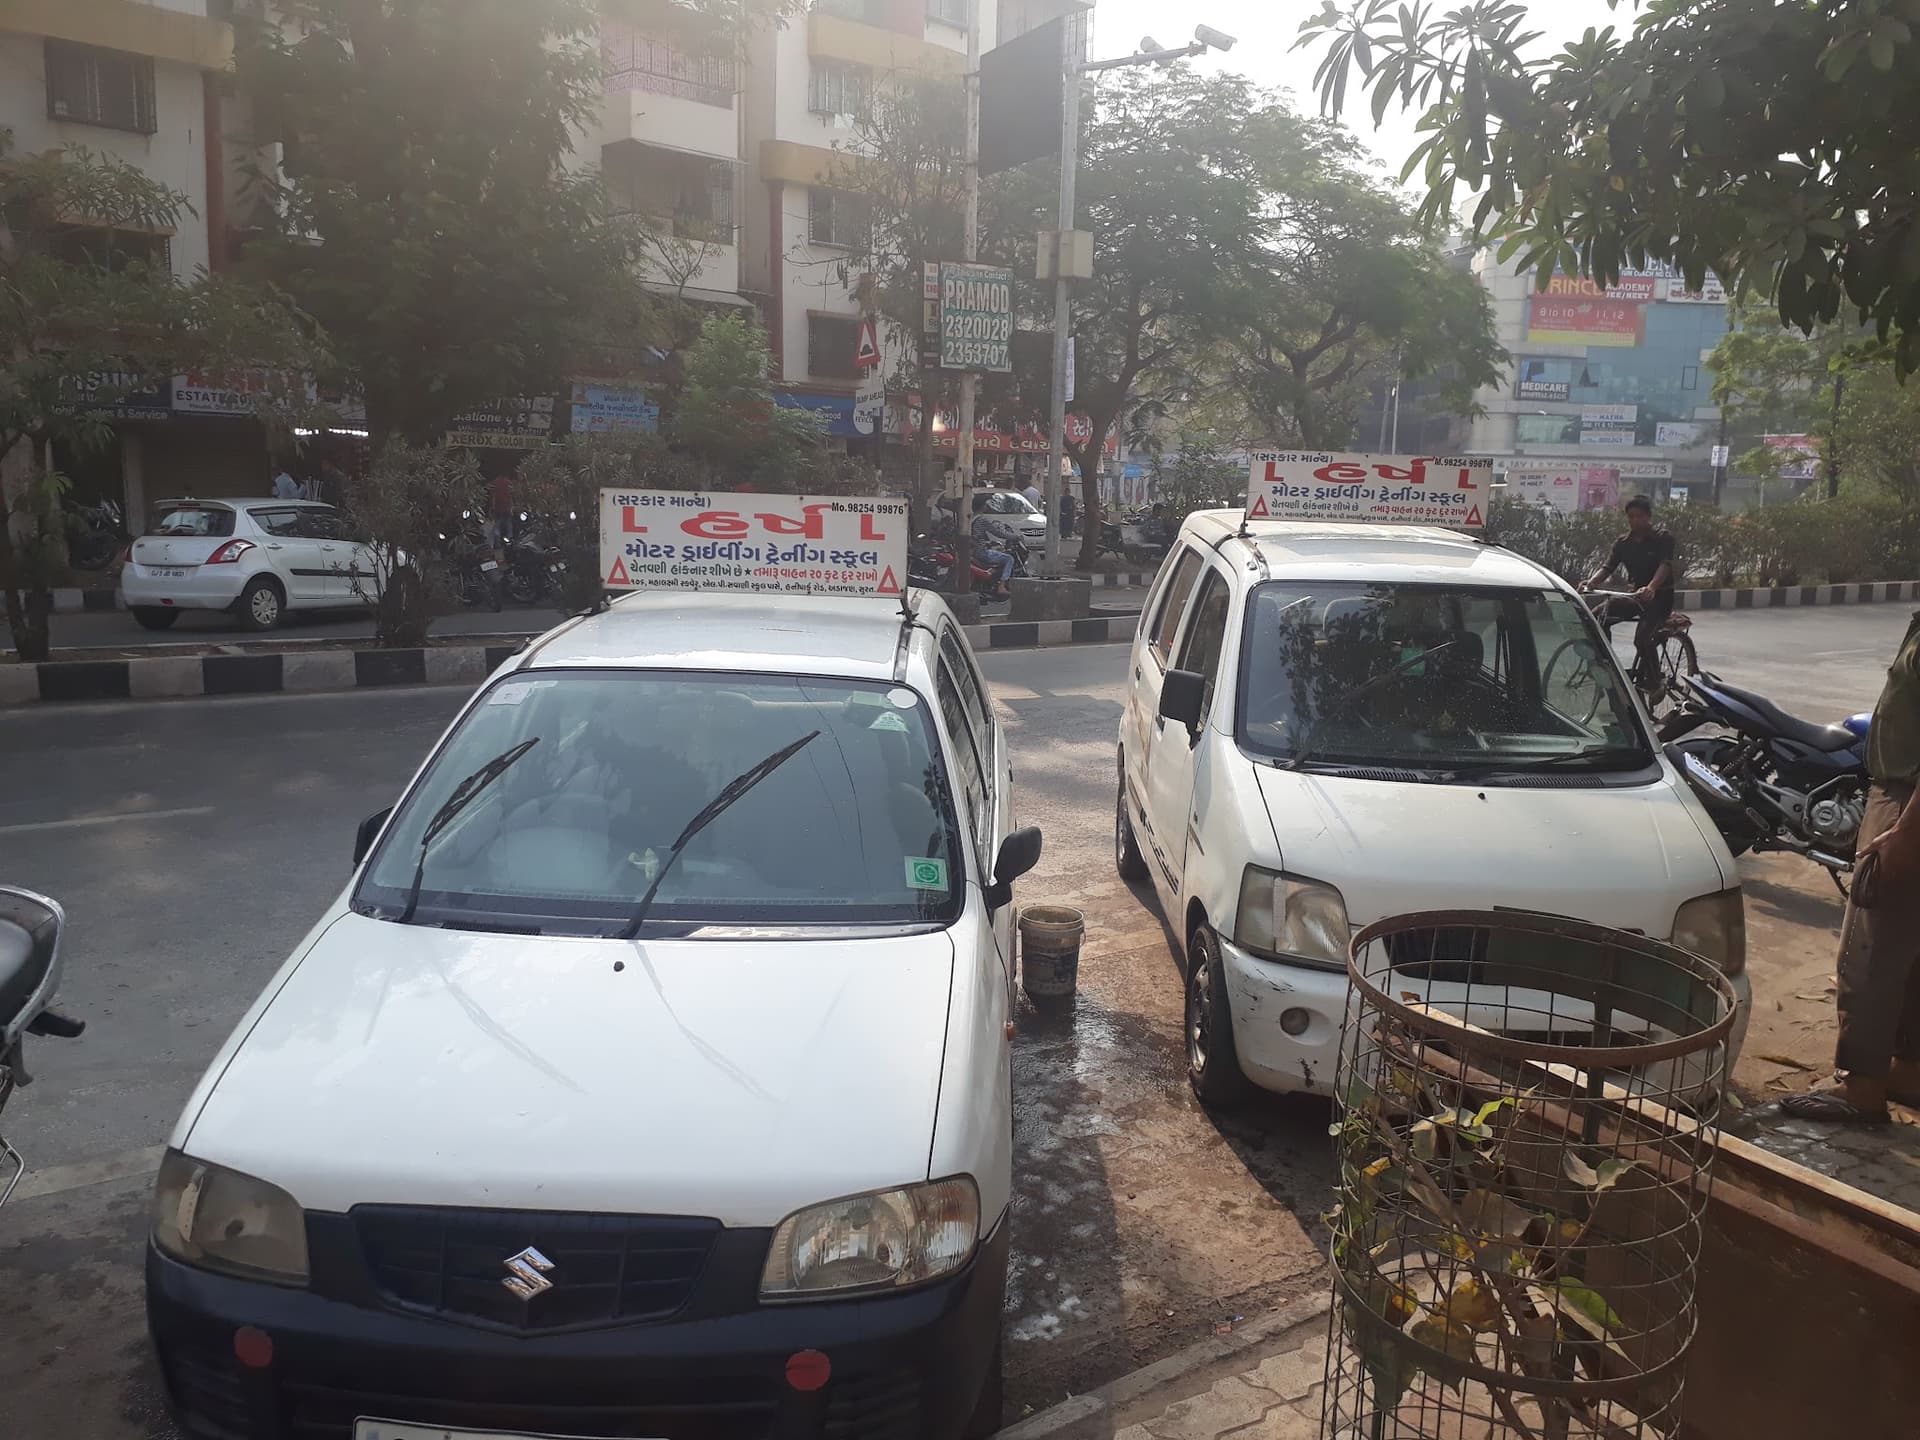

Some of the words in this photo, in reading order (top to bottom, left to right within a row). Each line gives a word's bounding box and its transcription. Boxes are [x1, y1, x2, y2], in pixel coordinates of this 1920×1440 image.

[945, 280, 1009, 313] PRAMOD
[1537, 279, 1602, 296] RINC
[946, 315, 1008, 340] 2320028
[946, 341, 1008, 365] 2353707
[1521, 382, 1568, 392] MEDICARE
[128, 409, 168, 420] Service
[1264, 462, 1284, 481] L
[1458, 469, 1477, 489] L
[612, 494, 665, 506] (સરકાર
[670, 495, 711, 508] માન્ય)
[1272, 482, 1310, 497] મોટર
[1379, 486, 1425, 503] ટ્રેનીંગ
[877, 504, 904, 515] 99876
[622, 506, 648, 533] L
[860, 514, 885, 540] L
[626, 539, 675, 559] મોટર
[681, 541, 760, 562] ડ્રાઈવીંગ
[766, 543, 824, 565] ટ્રેનીંગ
[630, 560, 666, 574] ચેતવણી
[734, 565, 743, 577] છે
[781, 568, 807, 578] વાહન
[809, 570, 822, 579] ૨૦
[856, 569, 878, 581] રાખો
